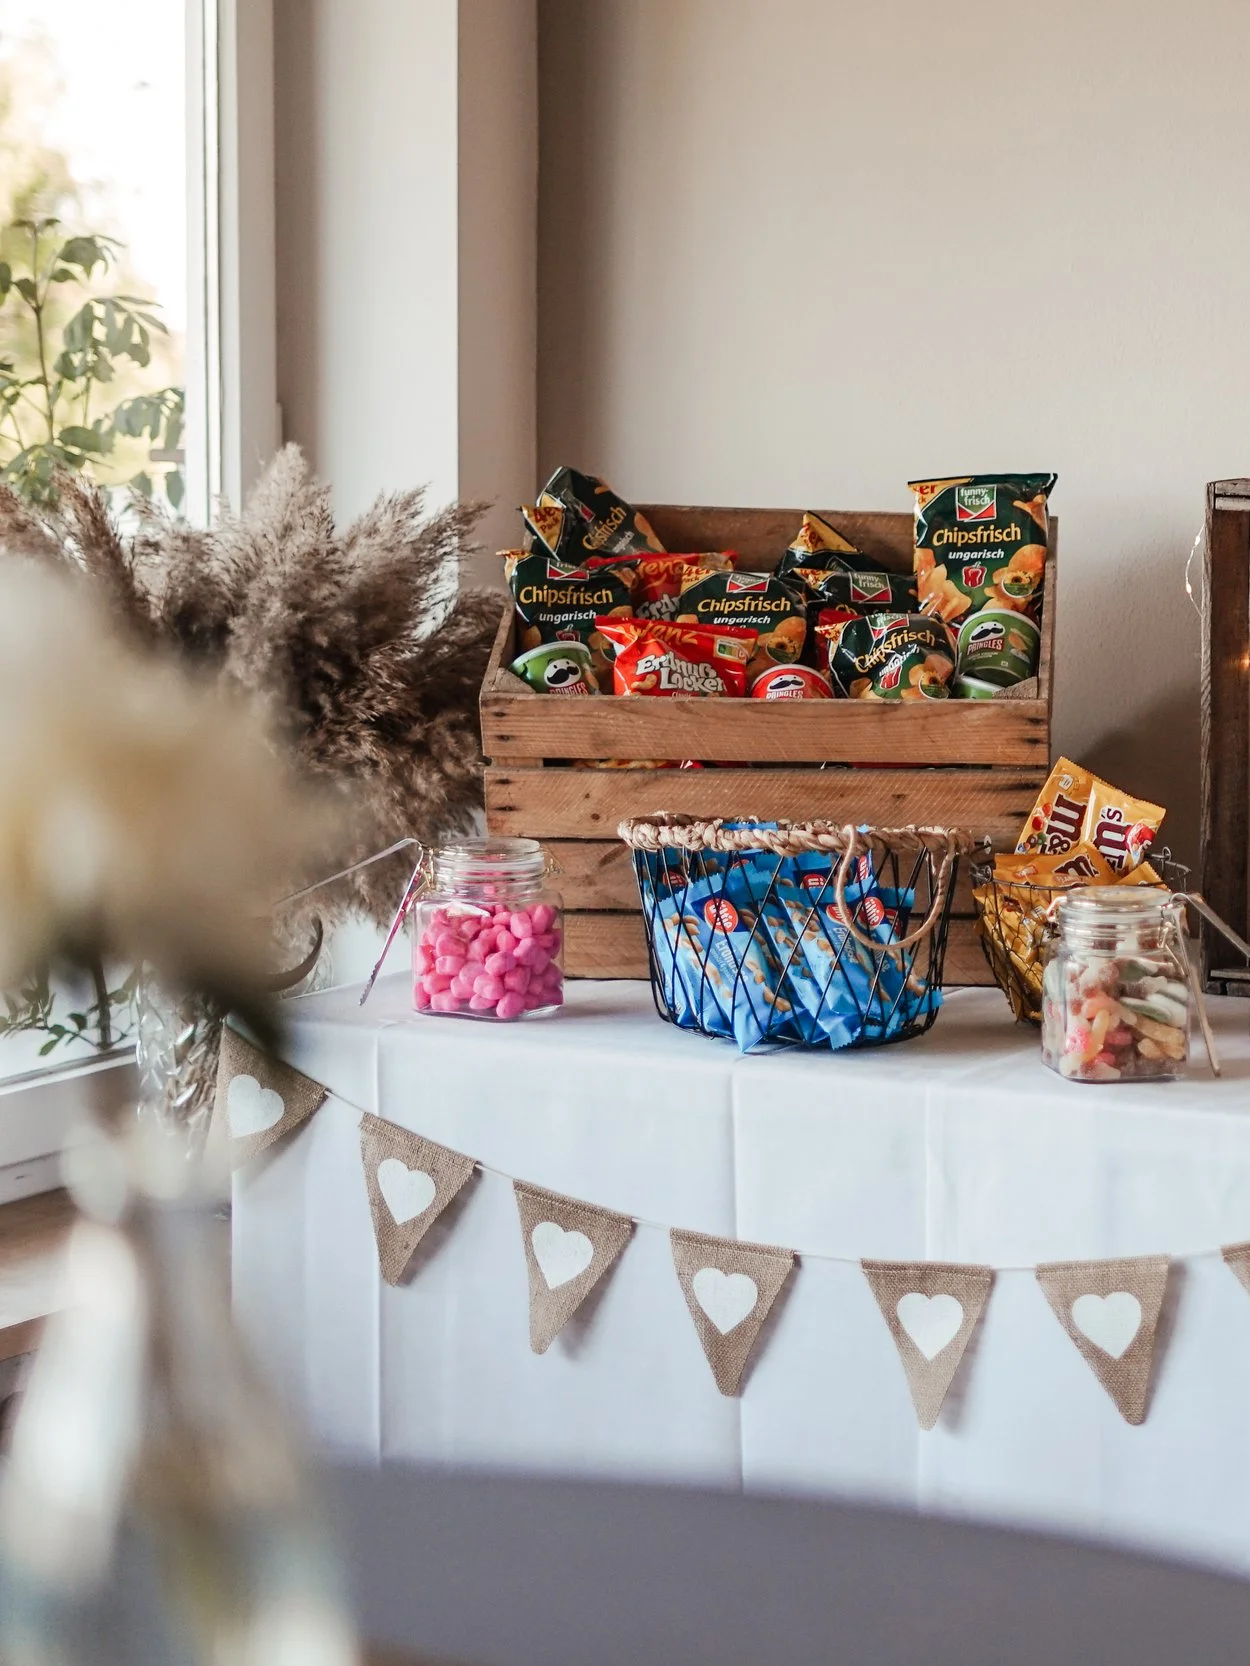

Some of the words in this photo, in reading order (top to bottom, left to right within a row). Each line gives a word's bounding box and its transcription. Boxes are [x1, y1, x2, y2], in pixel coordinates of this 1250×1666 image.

[960, 487, 989, 498] funny-
[964, 495, 991, 506] frisch
[931, 522, 1022, 547] Chipsfrisch
[948, 548, 1005, 561] ungarisch
[519, 584, 614, 607] Chipsfrisch
[697, 595, 792, 613] Chipsfrisch
[539, 609, 597, 624] ungarisch
[713, 615, 771, 625] ungarisch
[967, 639, 1003, 655] PRINGLES
